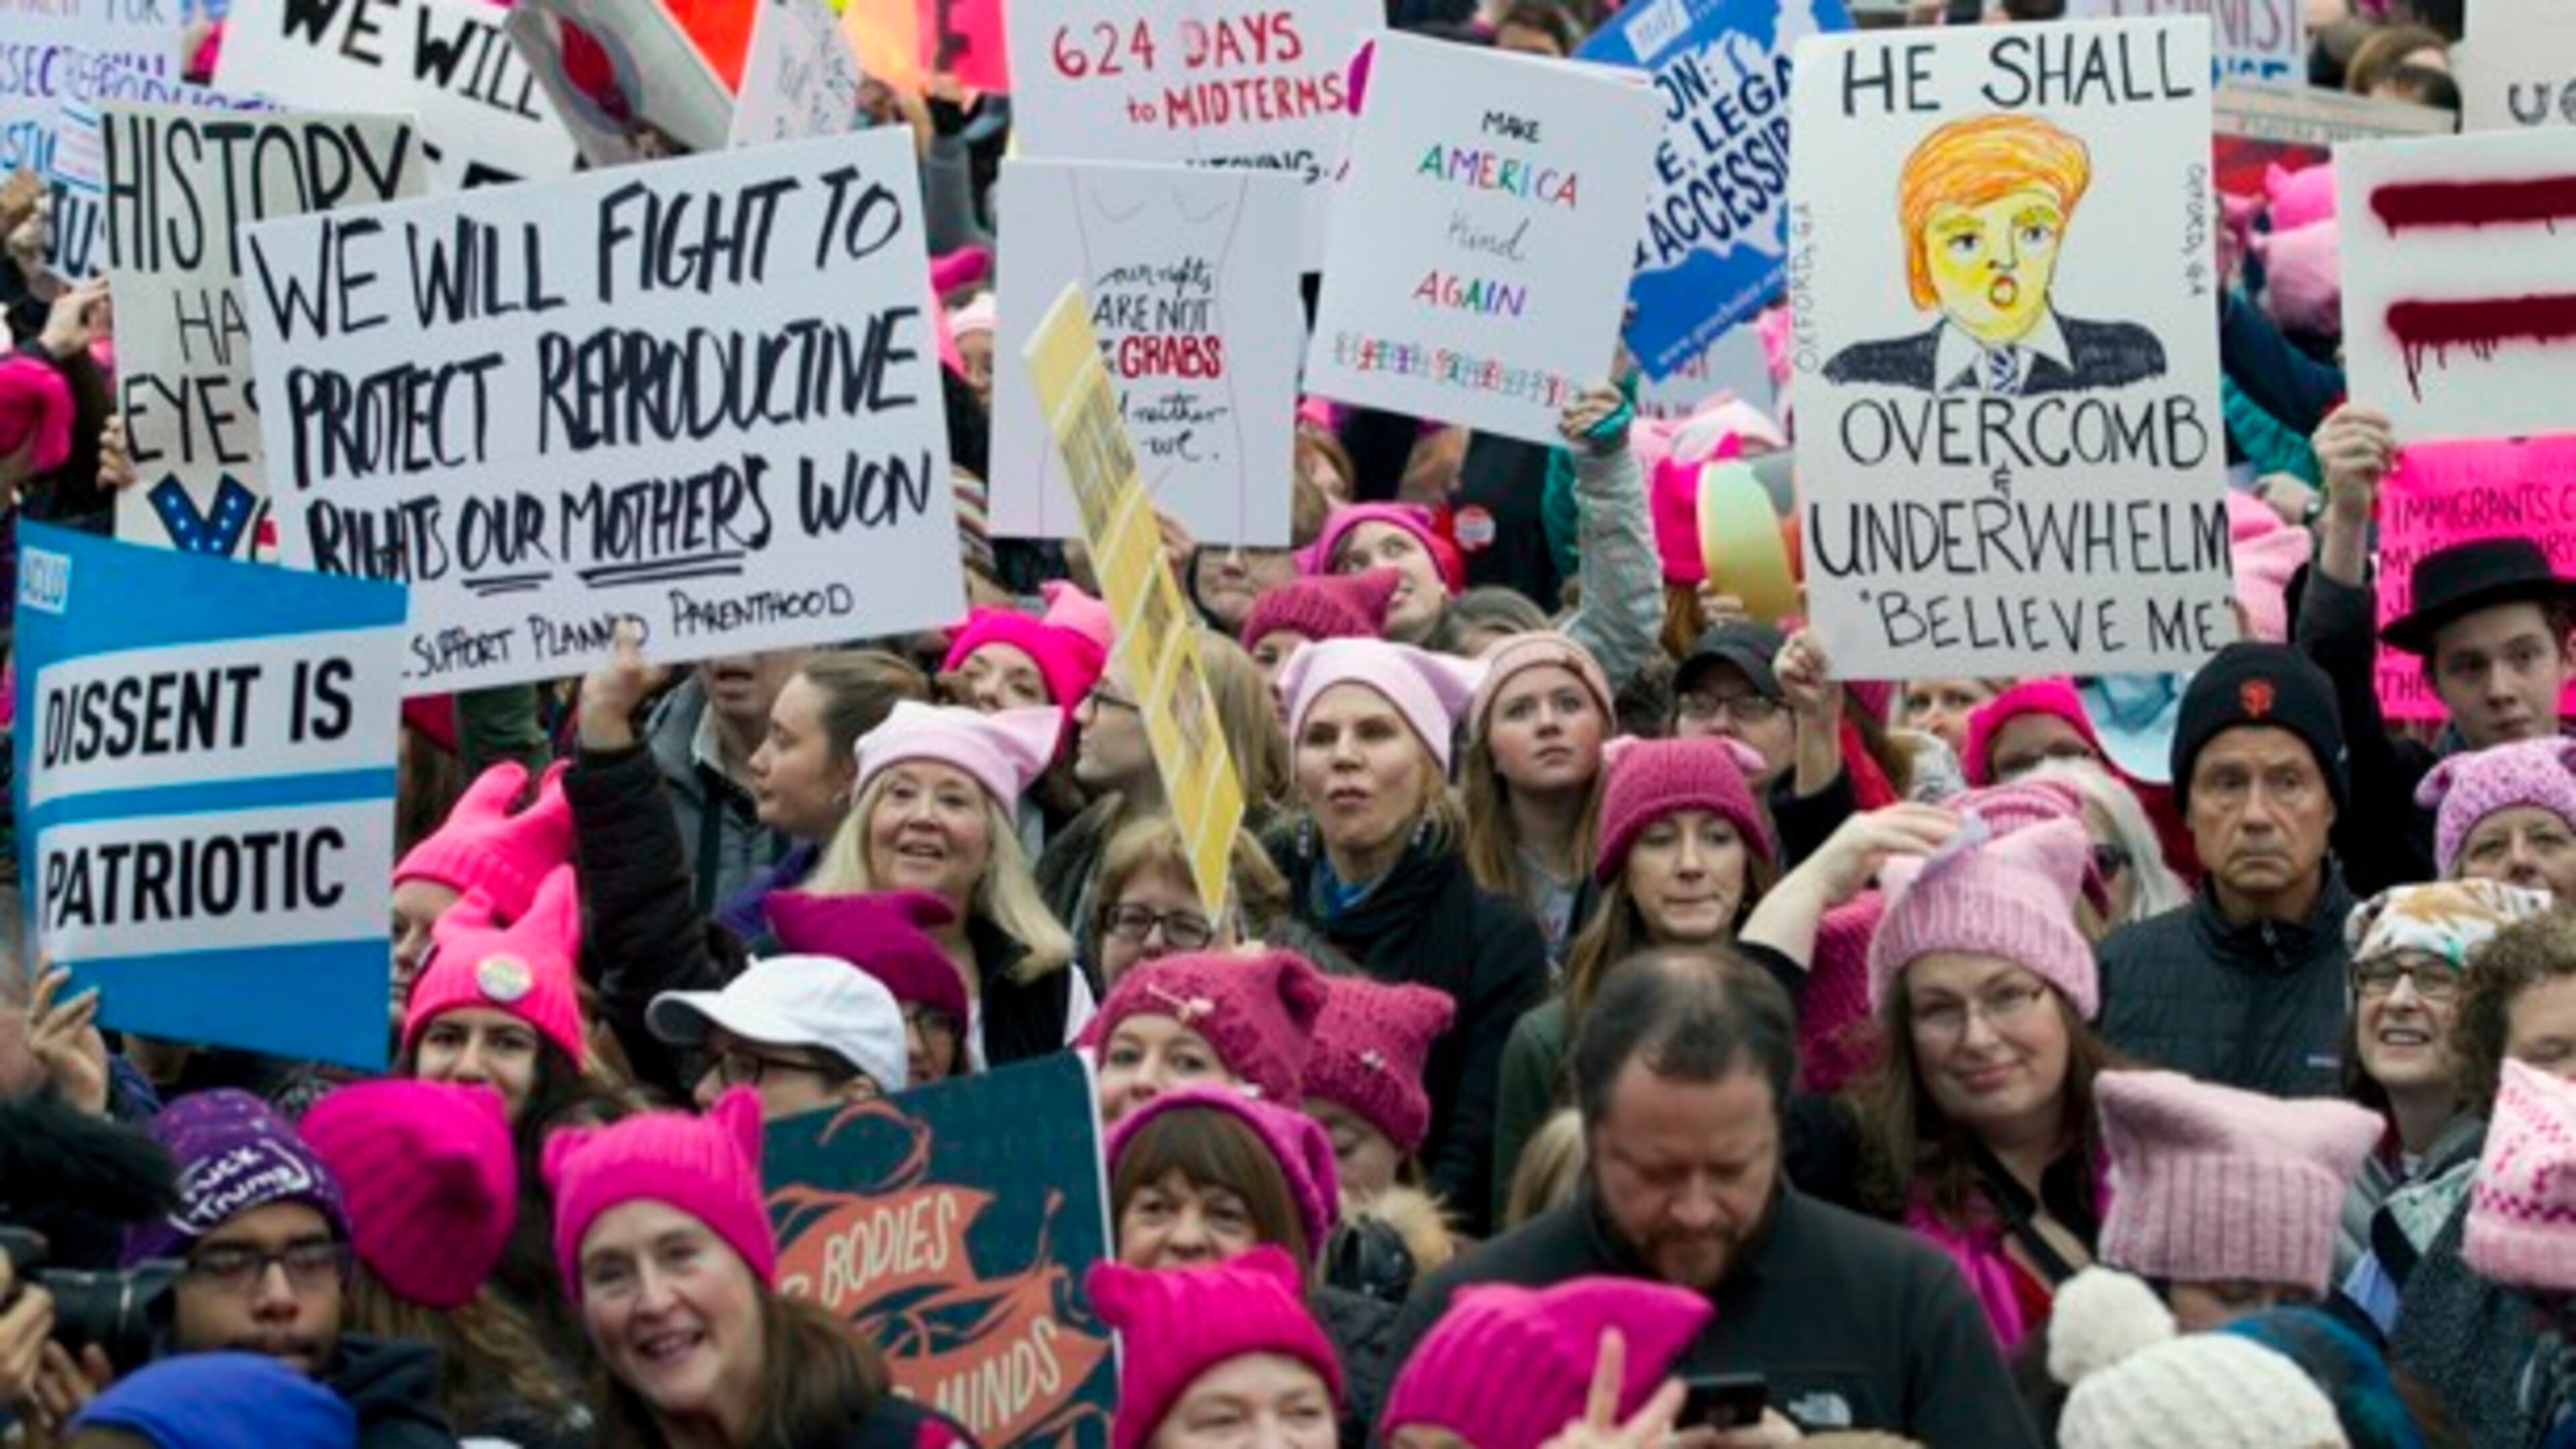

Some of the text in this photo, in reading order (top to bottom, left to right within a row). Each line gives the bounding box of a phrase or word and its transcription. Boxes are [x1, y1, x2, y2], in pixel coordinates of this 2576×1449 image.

[413, 5, 542, 123] WILL
[1053, 11, 1303, 78] 624 DAYS
[1843, 28, 2194, 117] HE SHALL
[1128, 72, 1344, 130] to MIDTERMS
[1482, 110, 1542, 144] MAKE
[1417, 143, 1578, 209] AMERICA
[249, 164, 902, 342] WE WILL FIGHT TO
[1091, 292, 1216, 333] ARE NOT
[1411, 270, 1527, 317] AGAIN
[1119, 334, 1222, 380] GRABS
[285, 306, 920, 489] PROTECT REPRODUCTIVE
[1841, 394, 2209, 470] OVERCOMB
[456, 491, 555, 572] OUR
[798, 449, 932, 538] WON
[1810, 497, 2234, 578] UNDERWHELM
[2392, 482, 2552, 534] IMMIGRANTS
[667, 582, 854, 638] PARENTHOOD
[42, 657, 354, 770] DISSENT IS
[42, 826, 346, 932] PATRIOTIC
[820, 1190, 958, 1310] BODIES
